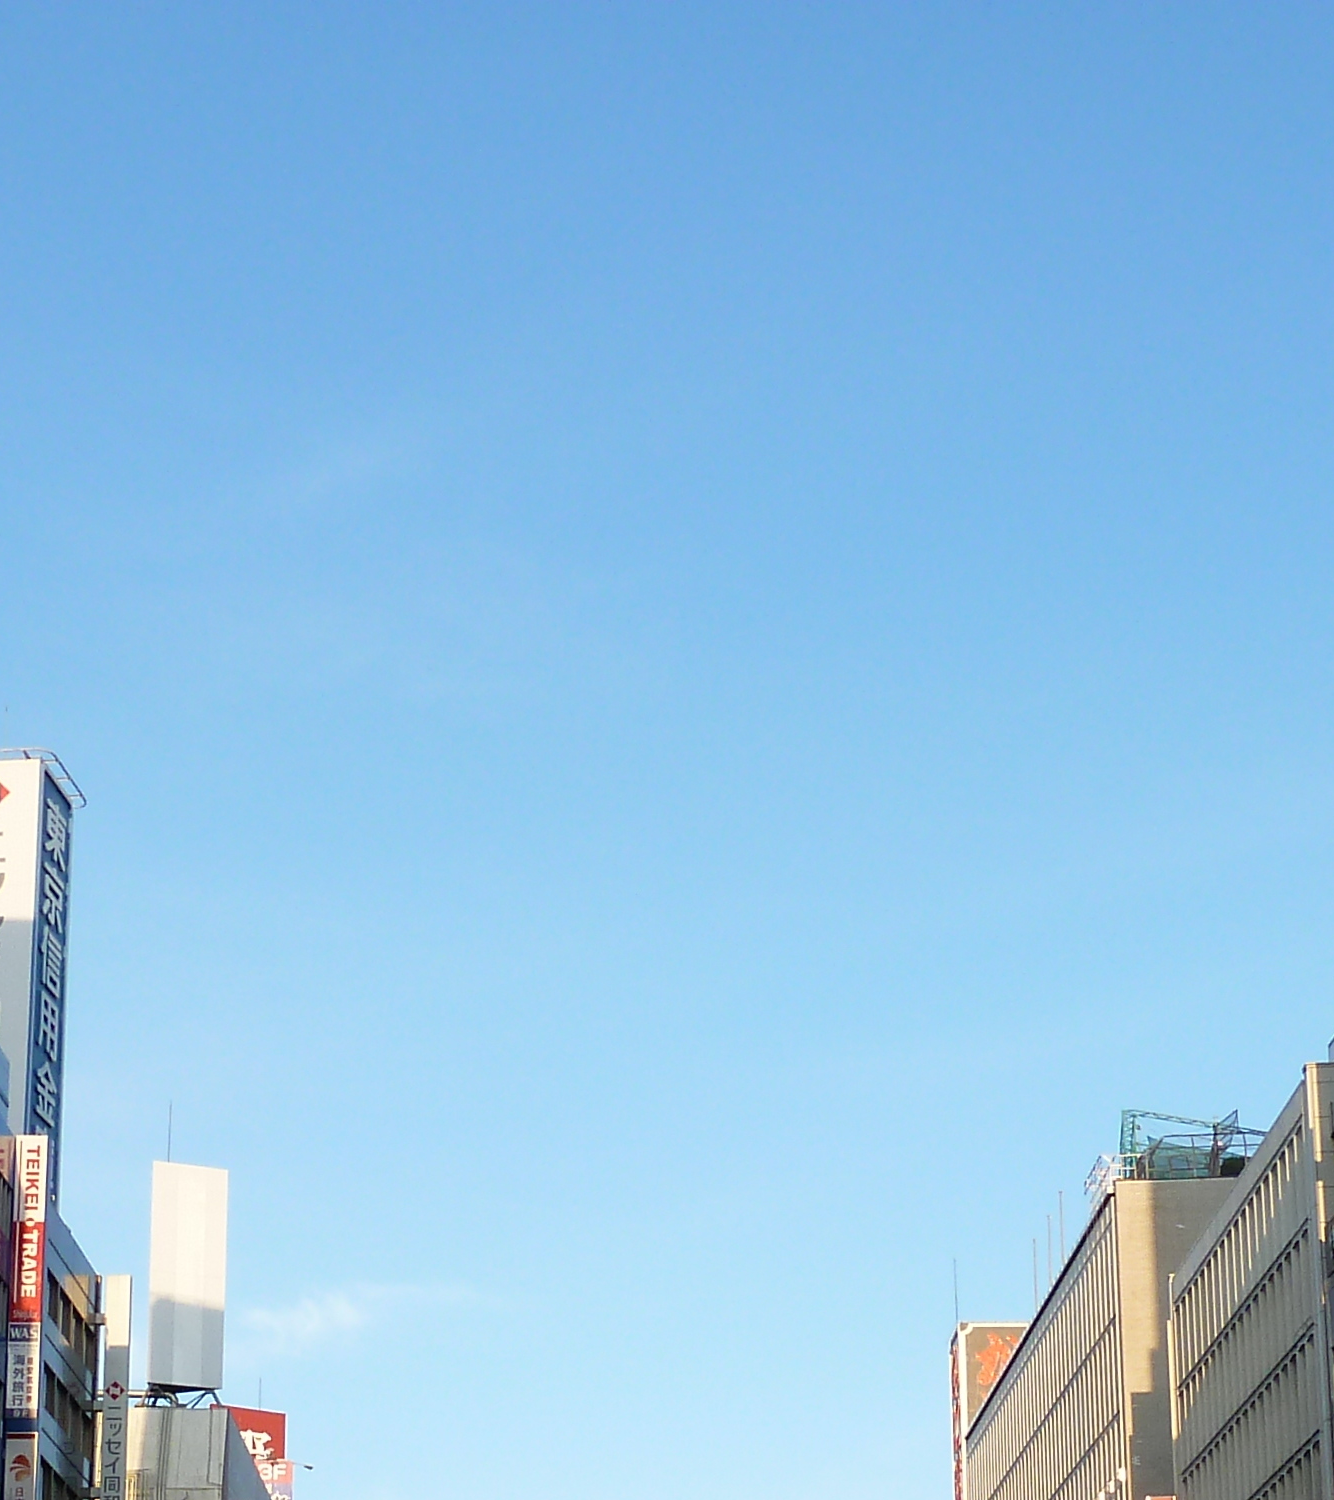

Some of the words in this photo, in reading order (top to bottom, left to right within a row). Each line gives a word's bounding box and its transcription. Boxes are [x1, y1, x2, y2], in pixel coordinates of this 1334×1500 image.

[34, 798, 68, 1140] 東京信用金
[24, 1144, 41, 1212] TEIKEI
[20, 1229, 40, 1298] TRADE
[10, 1327, 38, 1340] WAS
[12, 1354, 27, 1407] 海外旅行
